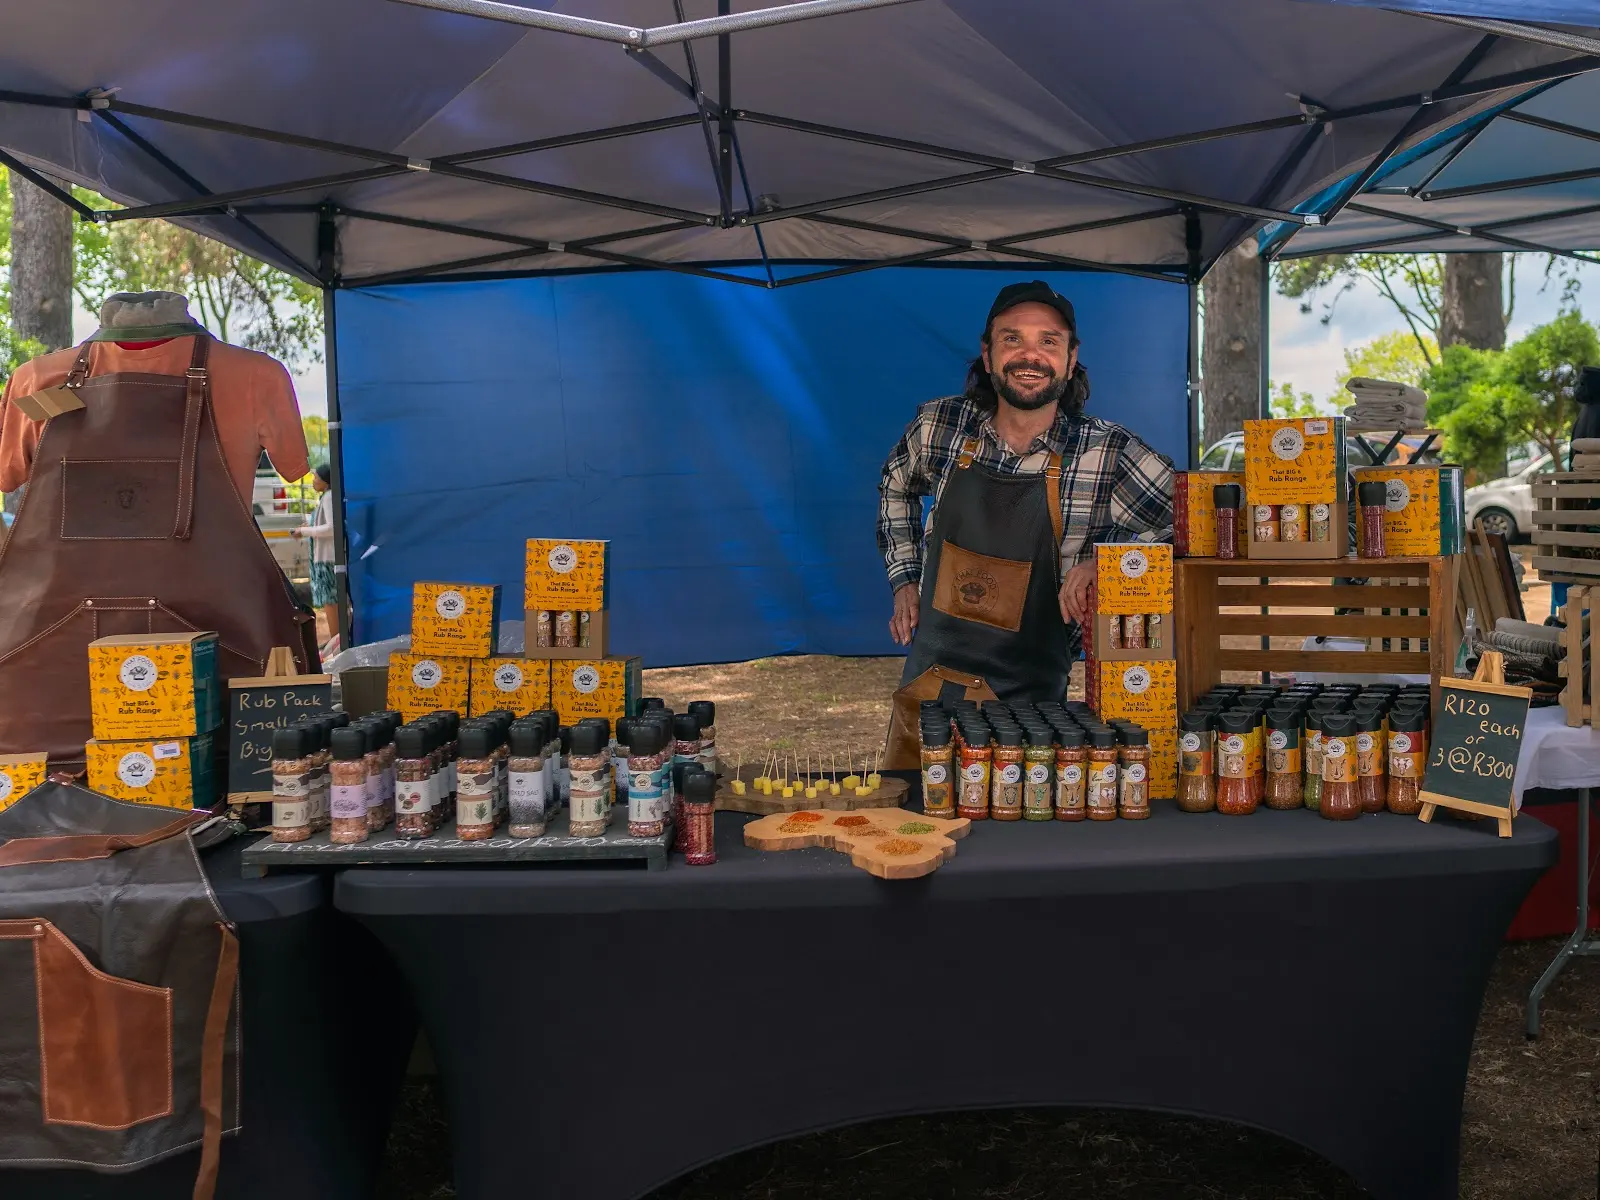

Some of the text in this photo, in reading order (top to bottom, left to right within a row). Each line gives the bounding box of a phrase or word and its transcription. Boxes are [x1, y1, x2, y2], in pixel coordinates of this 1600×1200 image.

[1284, 475, 1307, 483] Range
[447, 632, 467, 640] Range
[136, 707, 162, 715] Range
[240, 691, 322, 711] Rub Pack
[1444, 693, 1490, 716] R120
[235, 716, 288, 736] Small
[1480, 720, 1520, 740] each
[1465, 735, 1485, 745] or
[240, 741, 273, 762] Big
